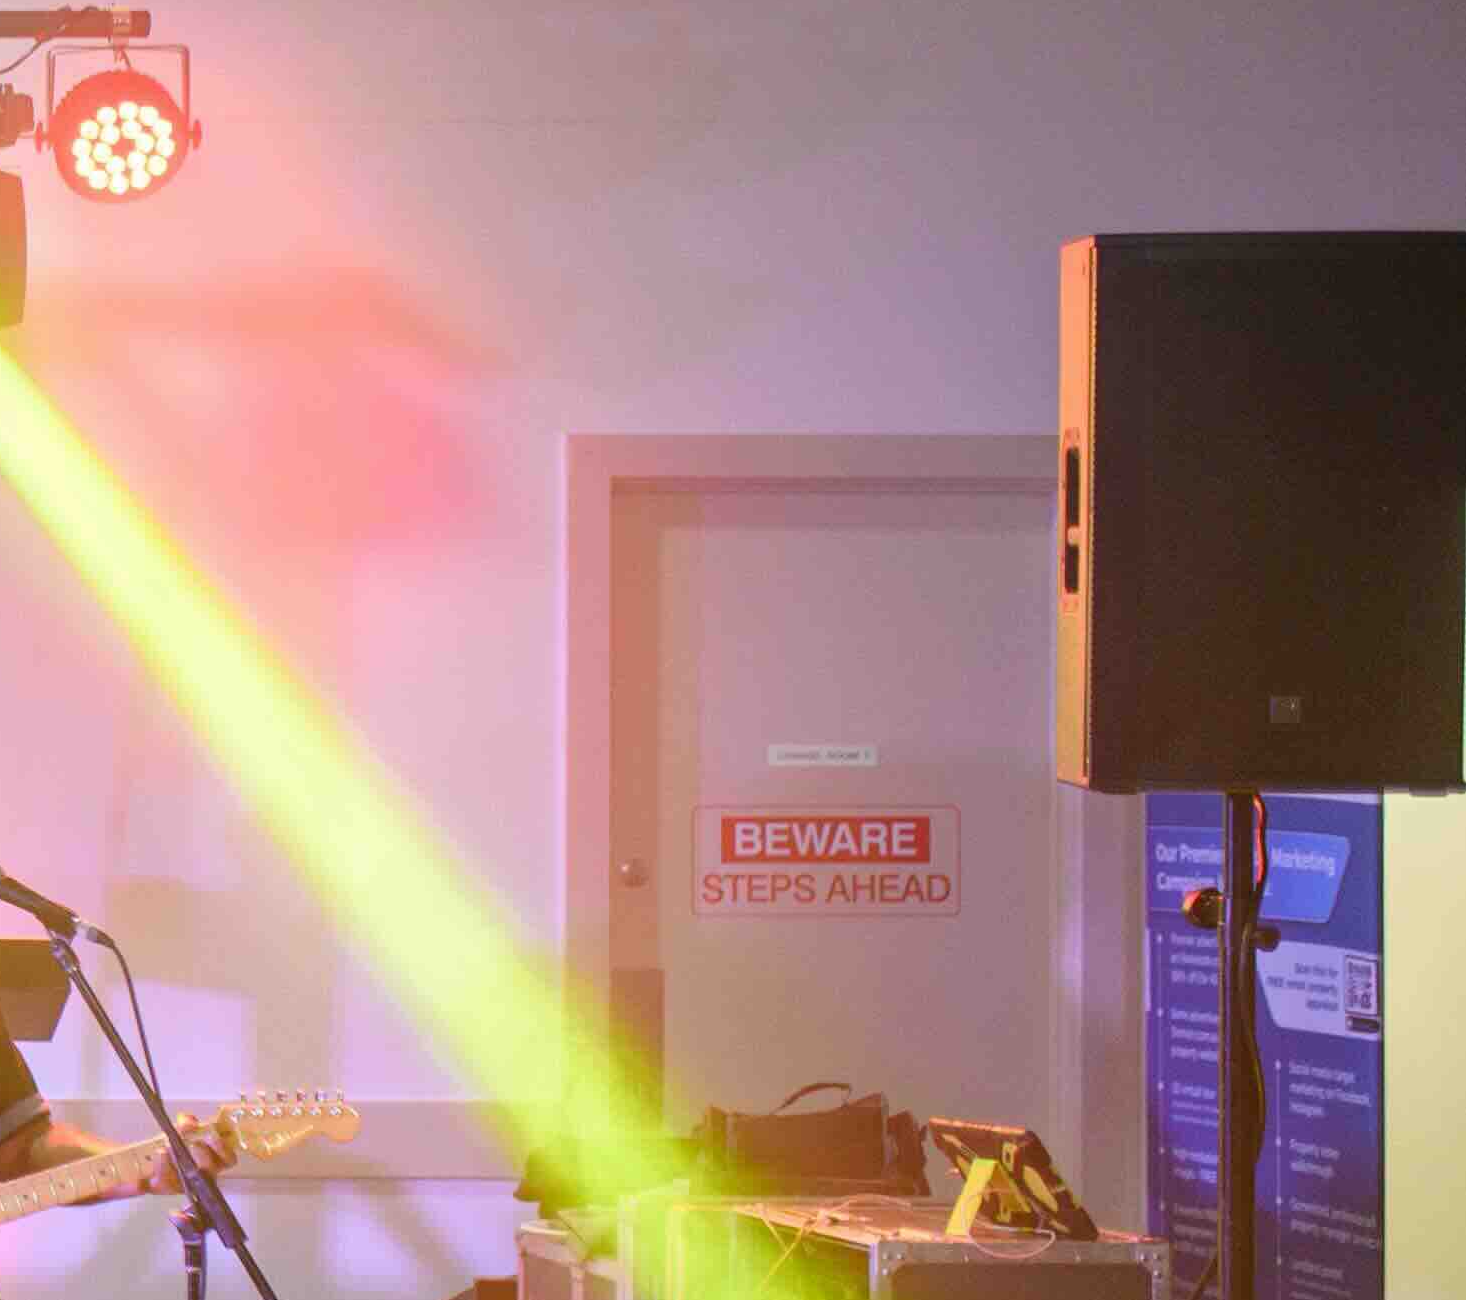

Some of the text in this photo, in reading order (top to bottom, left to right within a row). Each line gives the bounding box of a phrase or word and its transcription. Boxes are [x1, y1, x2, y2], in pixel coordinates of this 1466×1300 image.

[733, 819, 918, 859] BEWARE
[1271, 847, 1336, 877] Marketing
[701, 873, 951, 905] STEPS AHEAD
